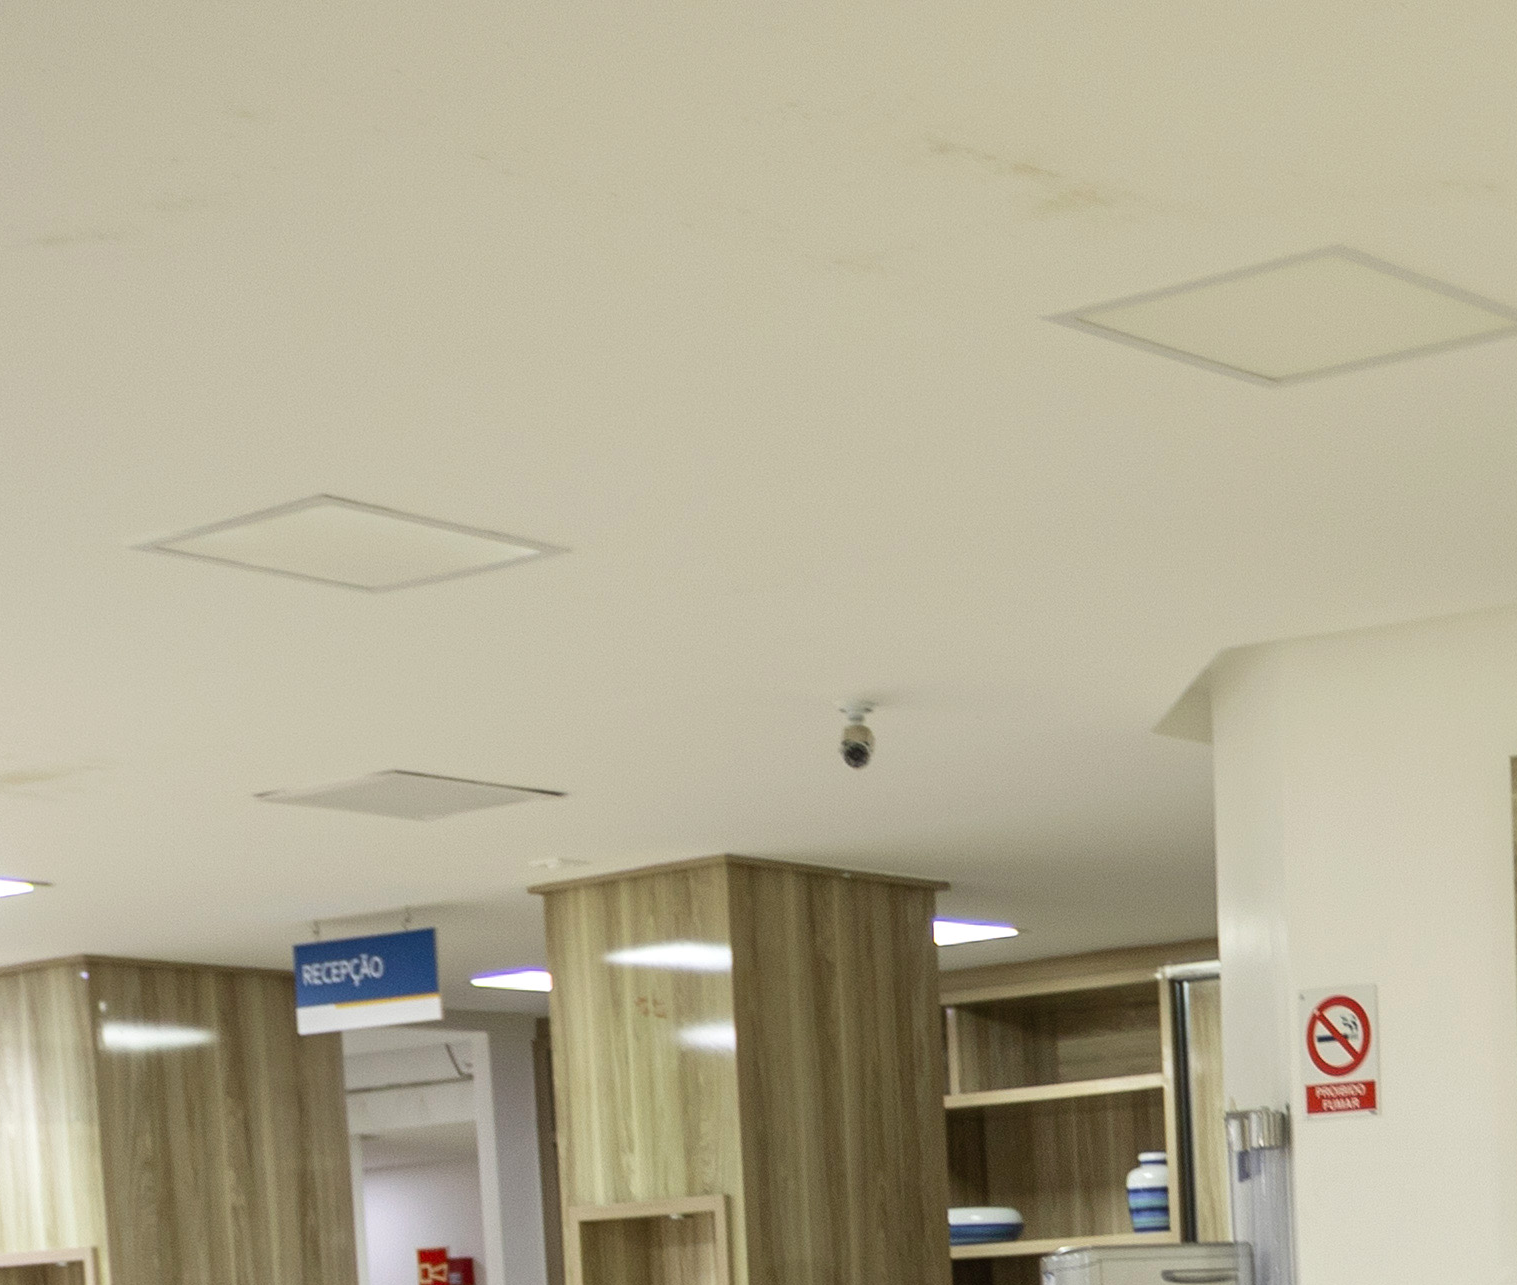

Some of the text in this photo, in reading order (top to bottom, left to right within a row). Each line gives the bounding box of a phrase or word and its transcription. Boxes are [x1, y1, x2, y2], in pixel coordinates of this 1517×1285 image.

[301, 954, 384, 987] RECEPÇÃO
[1315, 1082, 1366, 1099] PROIBIDO
[1322, 1097, 1360, 1111] FUMAR
